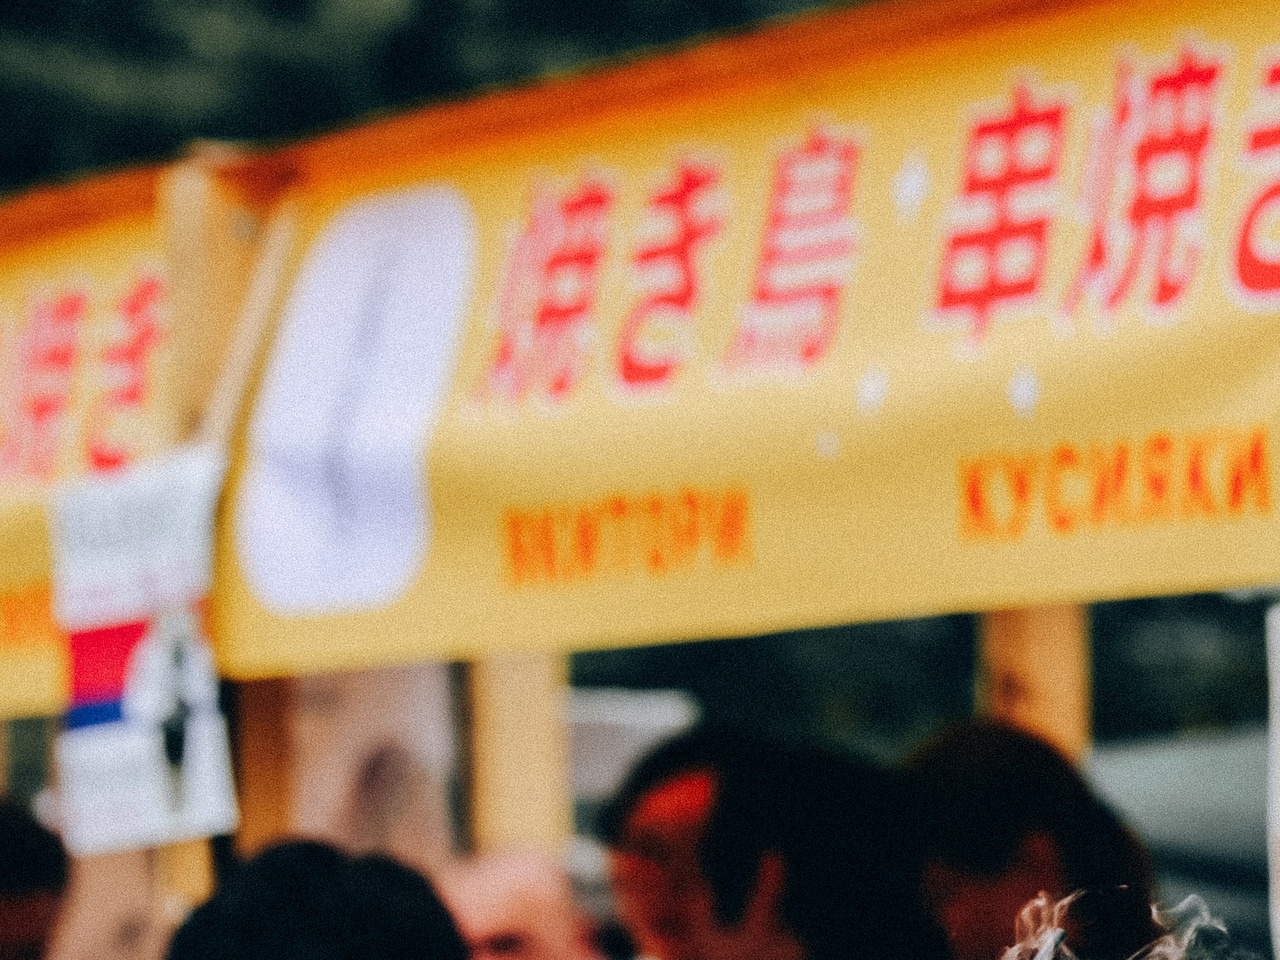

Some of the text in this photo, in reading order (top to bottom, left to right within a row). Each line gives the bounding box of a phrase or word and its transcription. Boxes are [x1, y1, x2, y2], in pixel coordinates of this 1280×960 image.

[478, 118, 866, 408] 焼き鳥
[958, 426, 1272, 542] КУСИЯКИ
